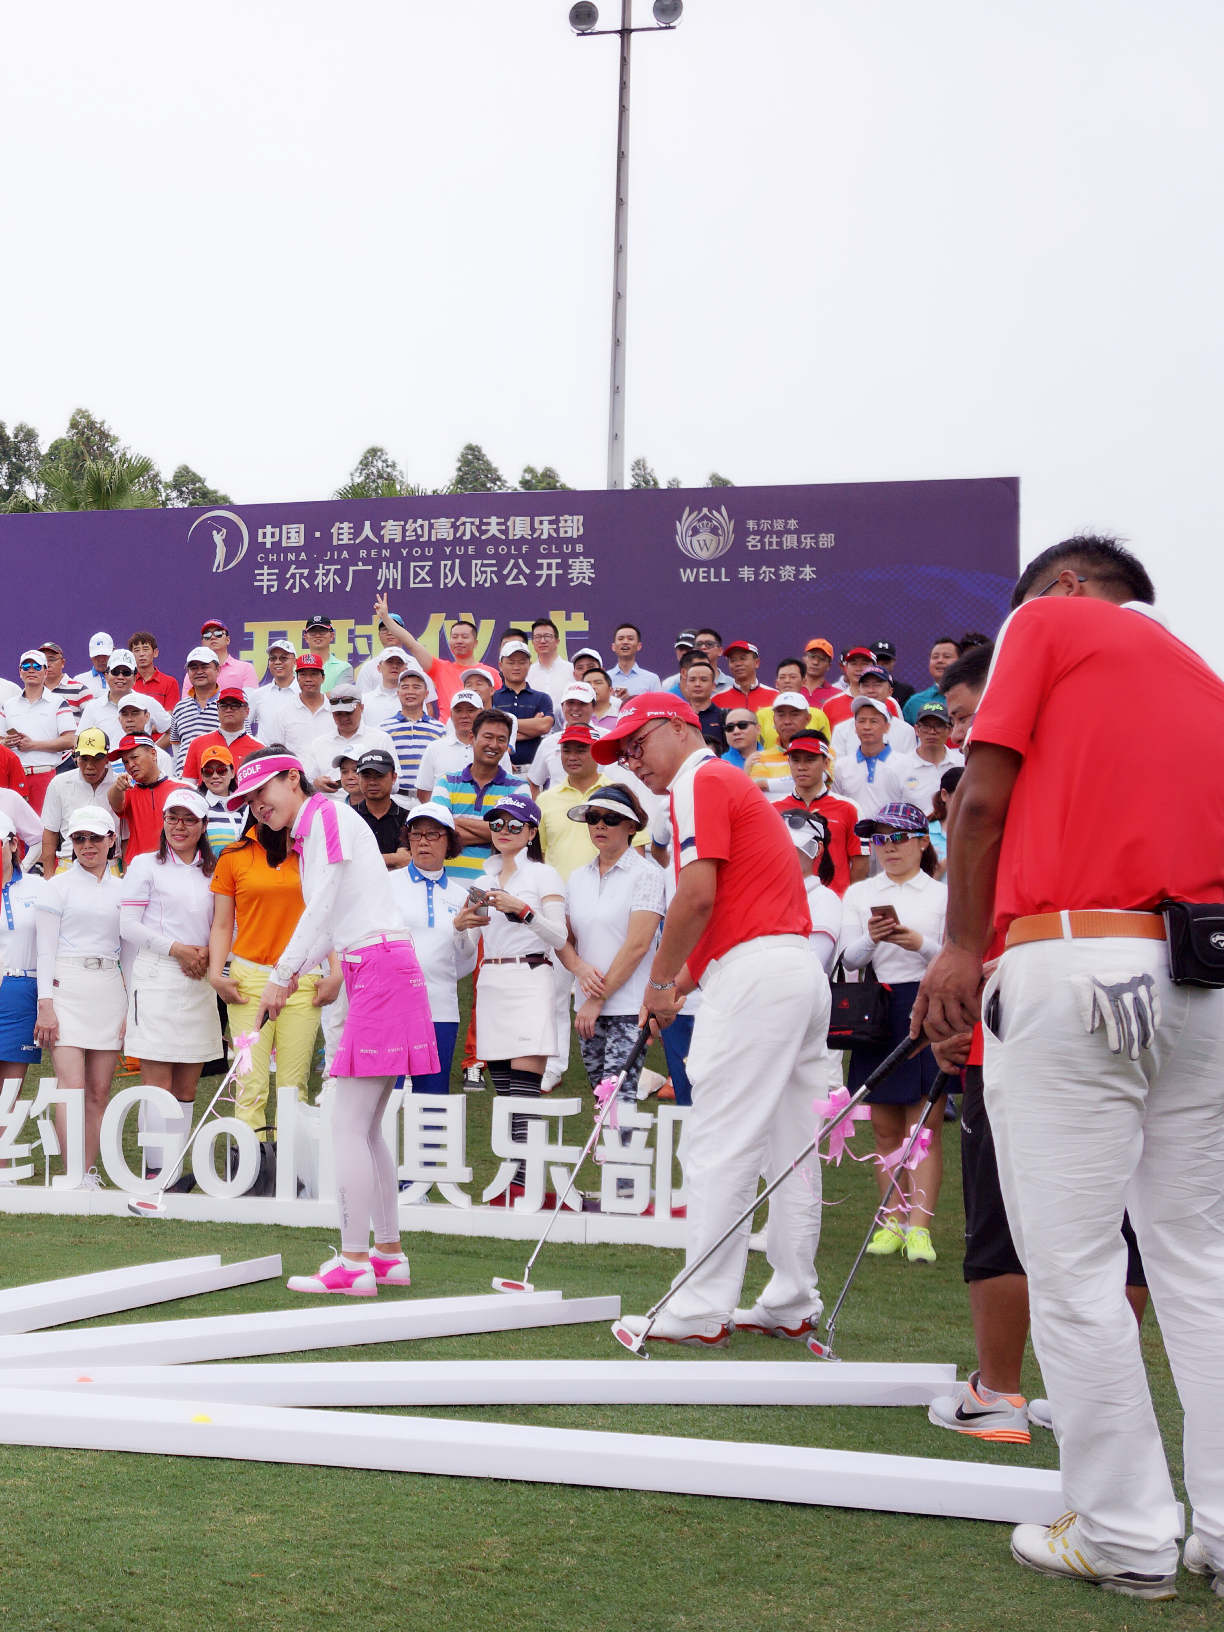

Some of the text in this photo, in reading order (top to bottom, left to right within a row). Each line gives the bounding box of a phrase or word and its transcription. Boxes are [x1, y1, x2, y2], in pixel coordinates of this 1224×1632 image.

[745, 518, 799, 532] 韦尔资本
[696, 539, 714, 553] W
[745, 533, 835, 551] 名仕俱乐部
[359, 548, 391, 558] REN
[401, 547, 434, 557] YOU
[443, 545, 477, 555] YUE
[486, 545, 530, 554] GOLF
[540, 543, 585, 553] CLUB
[253, 556, 596, 595] 韦尔杯广州区队际公开赛
[680, 564, 818, 583] WELL 韦尔资本
[362, 755, 383, 763] PING
[242, 764, 262, 777] GOLF
